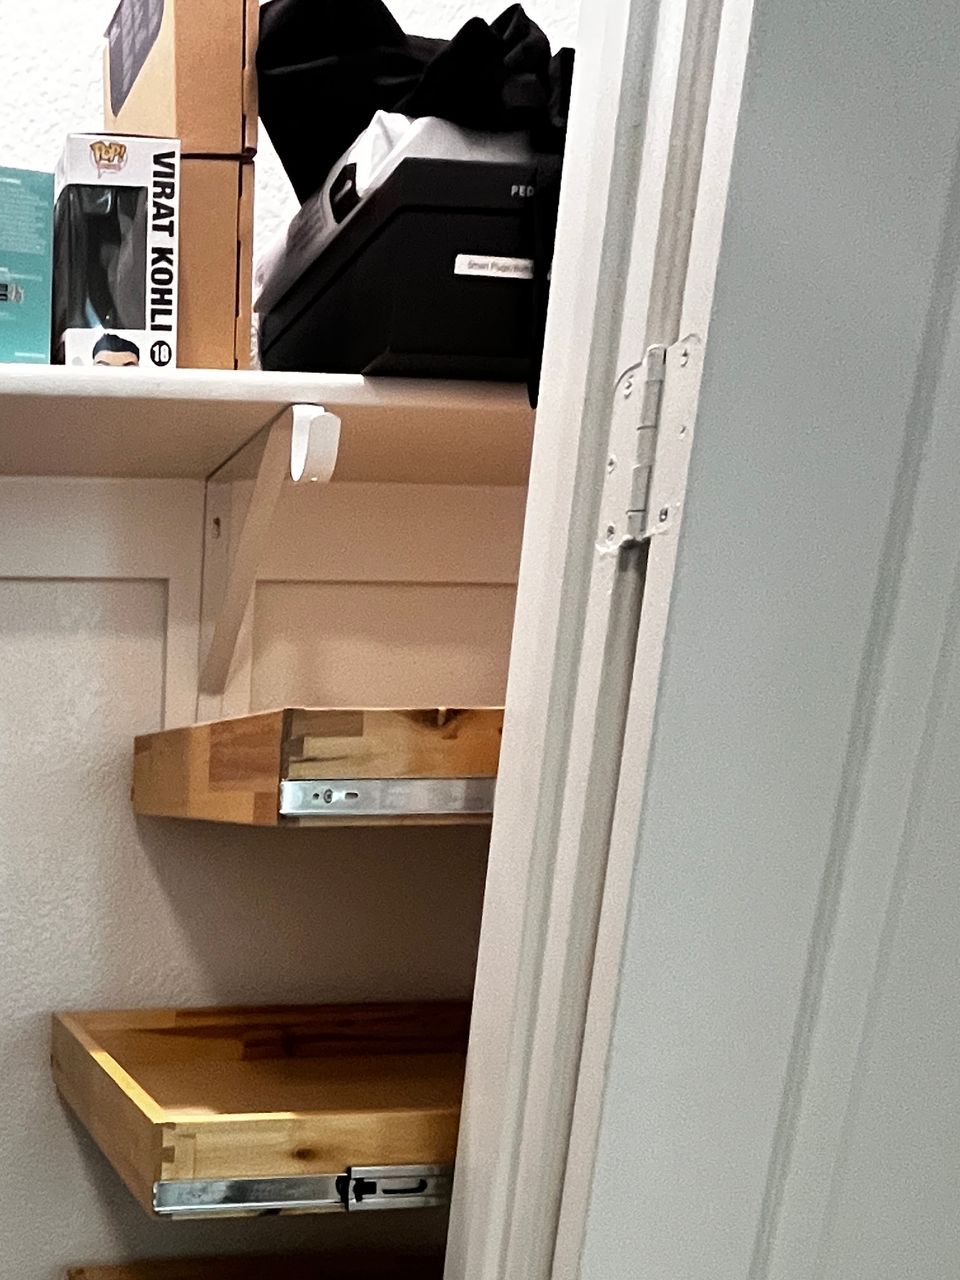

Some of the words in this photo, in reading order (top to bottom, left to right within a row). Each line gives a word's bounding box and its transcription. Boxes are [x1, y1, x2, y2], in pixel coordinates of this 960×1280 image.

[152, 151, 176, 237] VIRAT
[150, 247, 174, 331] KOHLI
[152, 344, 170, 362] 18
